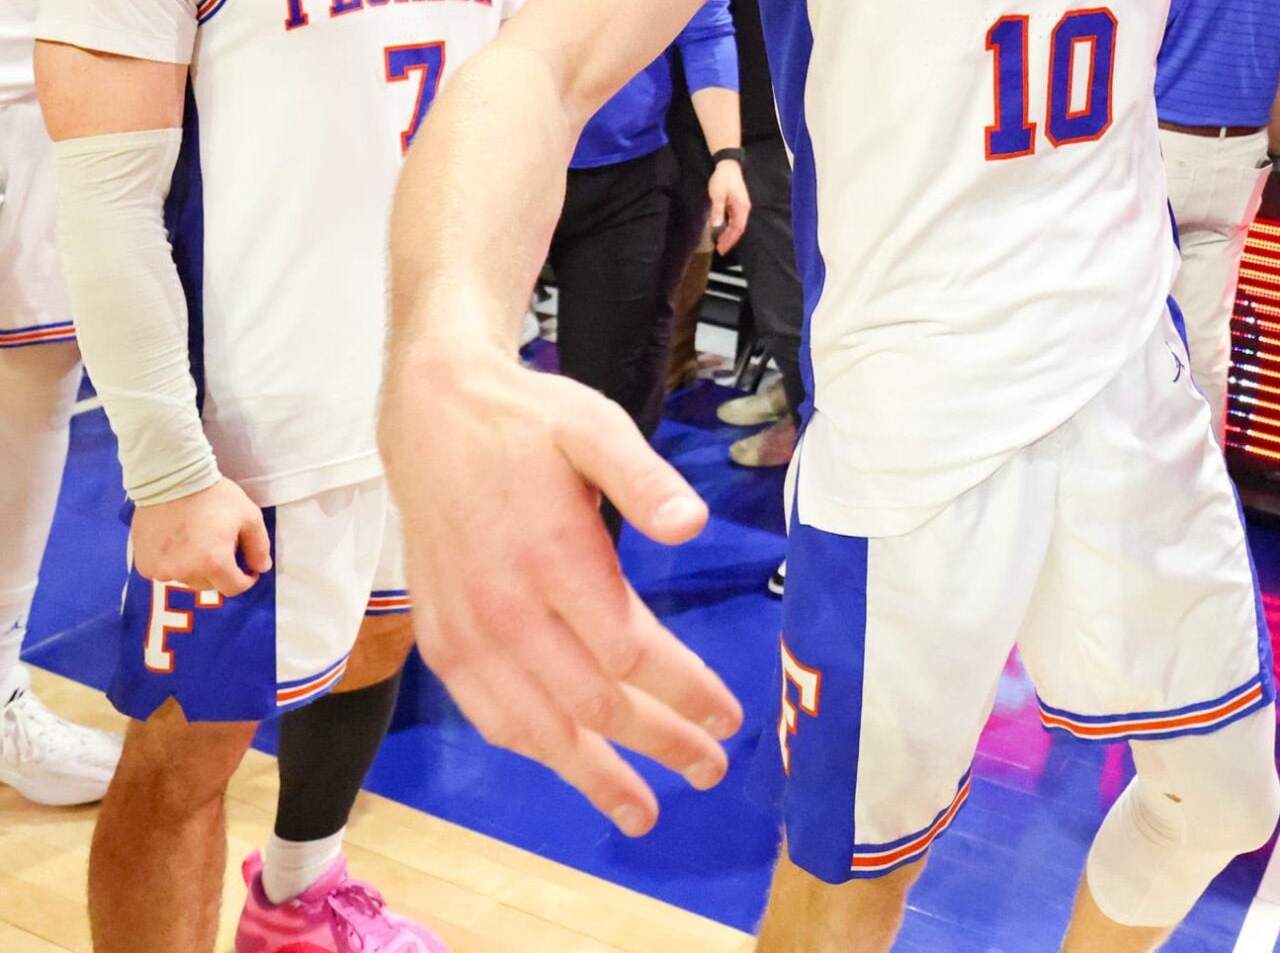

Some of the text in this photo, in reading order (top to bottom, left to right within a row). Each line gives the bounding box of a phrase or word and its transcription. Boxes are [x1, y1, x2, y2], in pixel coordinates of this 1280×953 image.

[384, 40, 446, 158] 7
[984, 6, 1118, 161] 10
[144, 578, 224, 674] F
